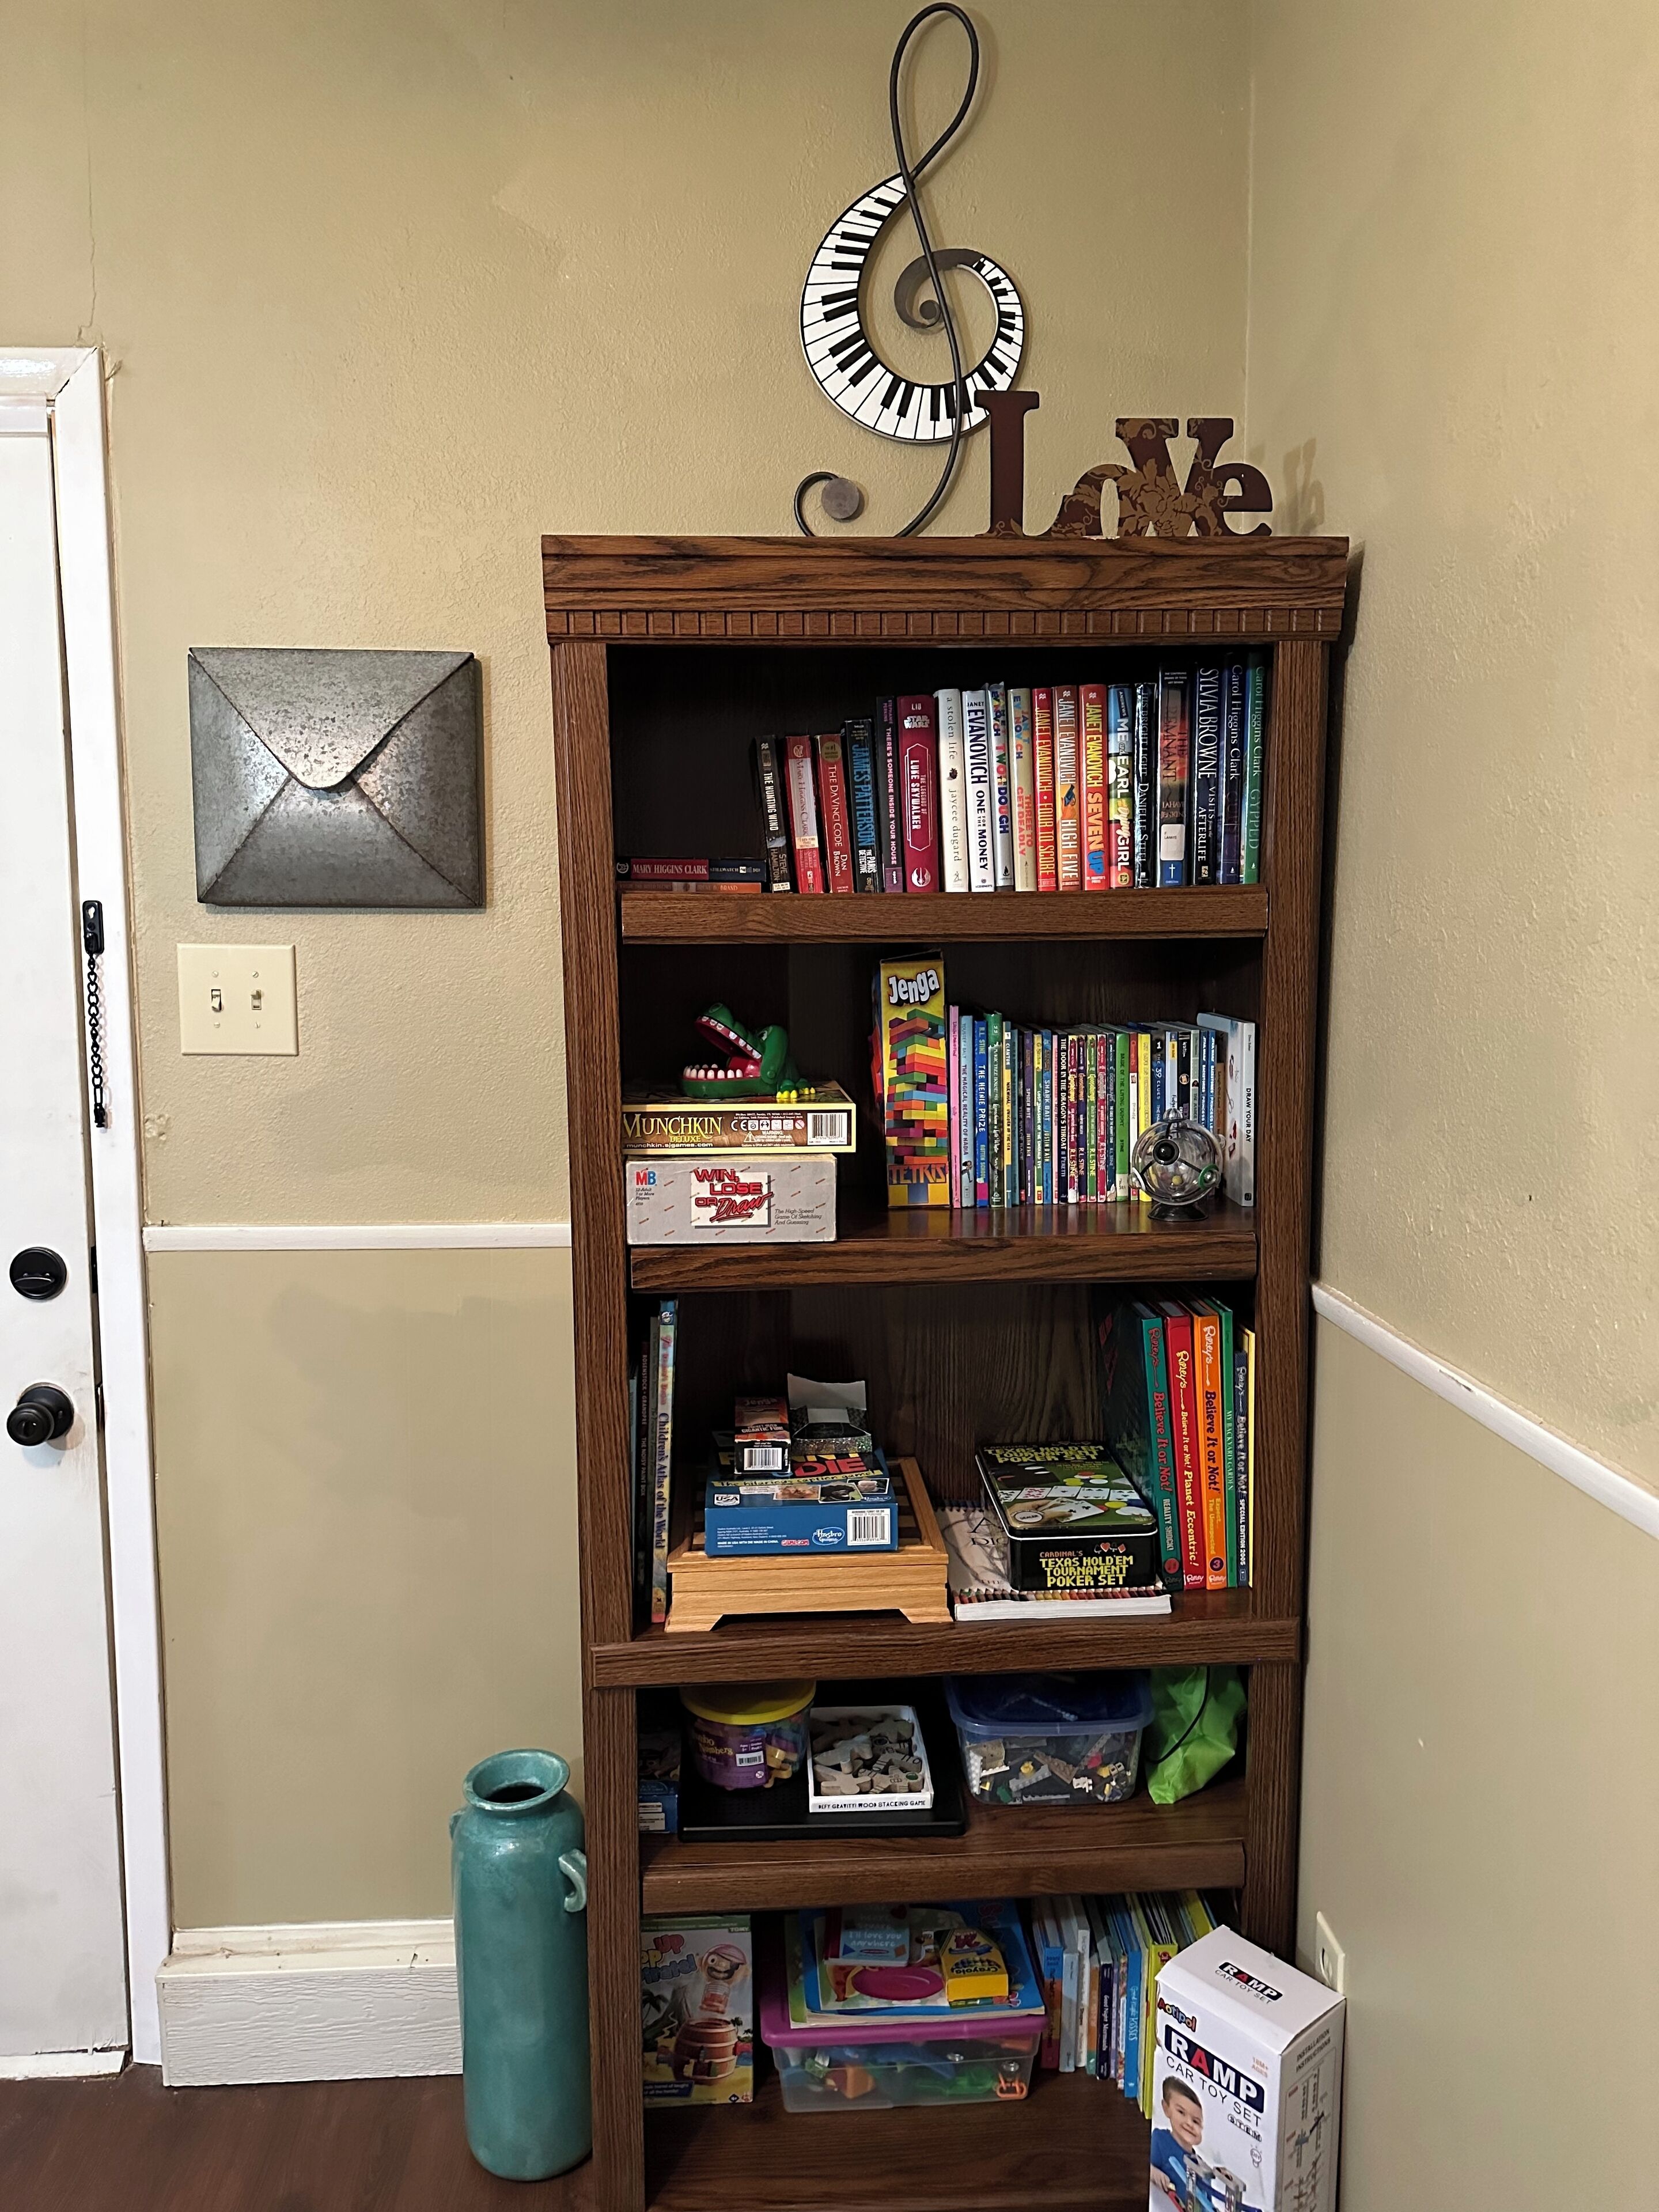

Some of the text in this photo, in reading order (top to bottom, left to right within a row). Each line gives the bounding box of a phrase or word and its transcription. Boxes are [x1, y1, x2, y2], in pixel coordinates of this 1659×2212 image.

[1232, 664, 1242, 696] Carol
[911, 703, 922, 711] LIU
[1119, 691, 1127, 717] ANDREWS
[948, 706, 956, 738] stolen
[1198, 668, 1219, 778] SYLVIA BROWNE
[1227, 700, 1241, 744] Higgins
[1252, 666, 1265, 777] Carol Higgins Clark
[949, 742, 957, 760] life
[967, 709, 987, 784] EVANOVICH
[852, 744, 872, 782] JAMES
[1229, 748, 1241, 780] Clark
[763, 772, 778, 831] THE HUNTING WIND
[910, 760, 921, 830] LUKE SKYWALKER
[976, 790, 985, 814] ONE
[1035, 707, 1055, 876] JANET EVANOVICH FOUR TO SCORE
[1058, 698, 1078, 879] JANET EVANOVICH HIGH FIVE
[1085, 703, 1105, 875] JANET EVANOVICH SEVEN UP
[854, 783, 874, 846] PATTERSON
[949, 789, 961, 862] jaycee dugard
[1138, 783, 1149, 863] DANIELLE STEEL
[1248, 789, 1261, 849] GYPPED
[978, 828, 988, 870] MONEY
[1018, 811, 1026, 856] DEADLY
[1027, 831, 1033, 847] TO
[1198, 806, 1207, 862] AFTERLIFE
[634, 865, 707, 874] MARY HIGGINS CLARK
[770, 849, 781, 880] HAMILTON
[779, 853, 787, 874] STEVE
[833, 851, 841, 876] BROWN
[858, 849, 867, 874] DETECTIVE
[888, 969, 940, 1003] Jenga
[623, 1113, 723, 1139] MUNCHKIN
[635, 1171, 656, 1185] MB
[694, 1168, 739, 1183] WIN,
[709, 1182, 763, 1195] LOSE
[889, 1164, 946, 1184] TETRIS
[695, 1197, 718, 1207] OR
[716, 1191, 774, 1217] Draw
[657, 1412, 670, 1461] Children's
[657, 1464, 668, 1489] Atlas
[794, 1457, 867, 1477] DIE
[656, 1502, 667, 1518] the
[657, 1490, 668, 1502] of
[656, 1519, 666, 1549] World
[813, 1528, 842, 1539] Hasbro
[1162, 1498, 1174, 1551] REALITY SHOCK!
[1210, 1512, 1218, 1554] Unexpected
[1039, 1550, 1084, 1558] CARDINAL'S
[1039, 1554, 1134, 1569] TEXAS HOLD'EM
[1044, 1565, 1129, 1577] TOURNAMENT
[1047, 1574, 1126, 1588] POKER SET
[653, 1934, 685, 1955] UP
[886, 1931, 902, 1940] you
[955, 1966, 998, 1975] Crayola
[1222, 1964, 1278, 1997] RAMP
[1215, 1969, 1272, 2005] CAR TOY SET
[1157, 1997, 1197, 2033] Aotipol
[1296, 2027, 1330, 2062] INSTALLATION
[1296, 2037, 1331, 2073] INSTRUCTIONS
[1170, 2030, 1258, 2102] RAMP
[1166, 2055, 1262, 2127] CAR TOY SET
[1228, 2113, 1262, 2143] STEM
